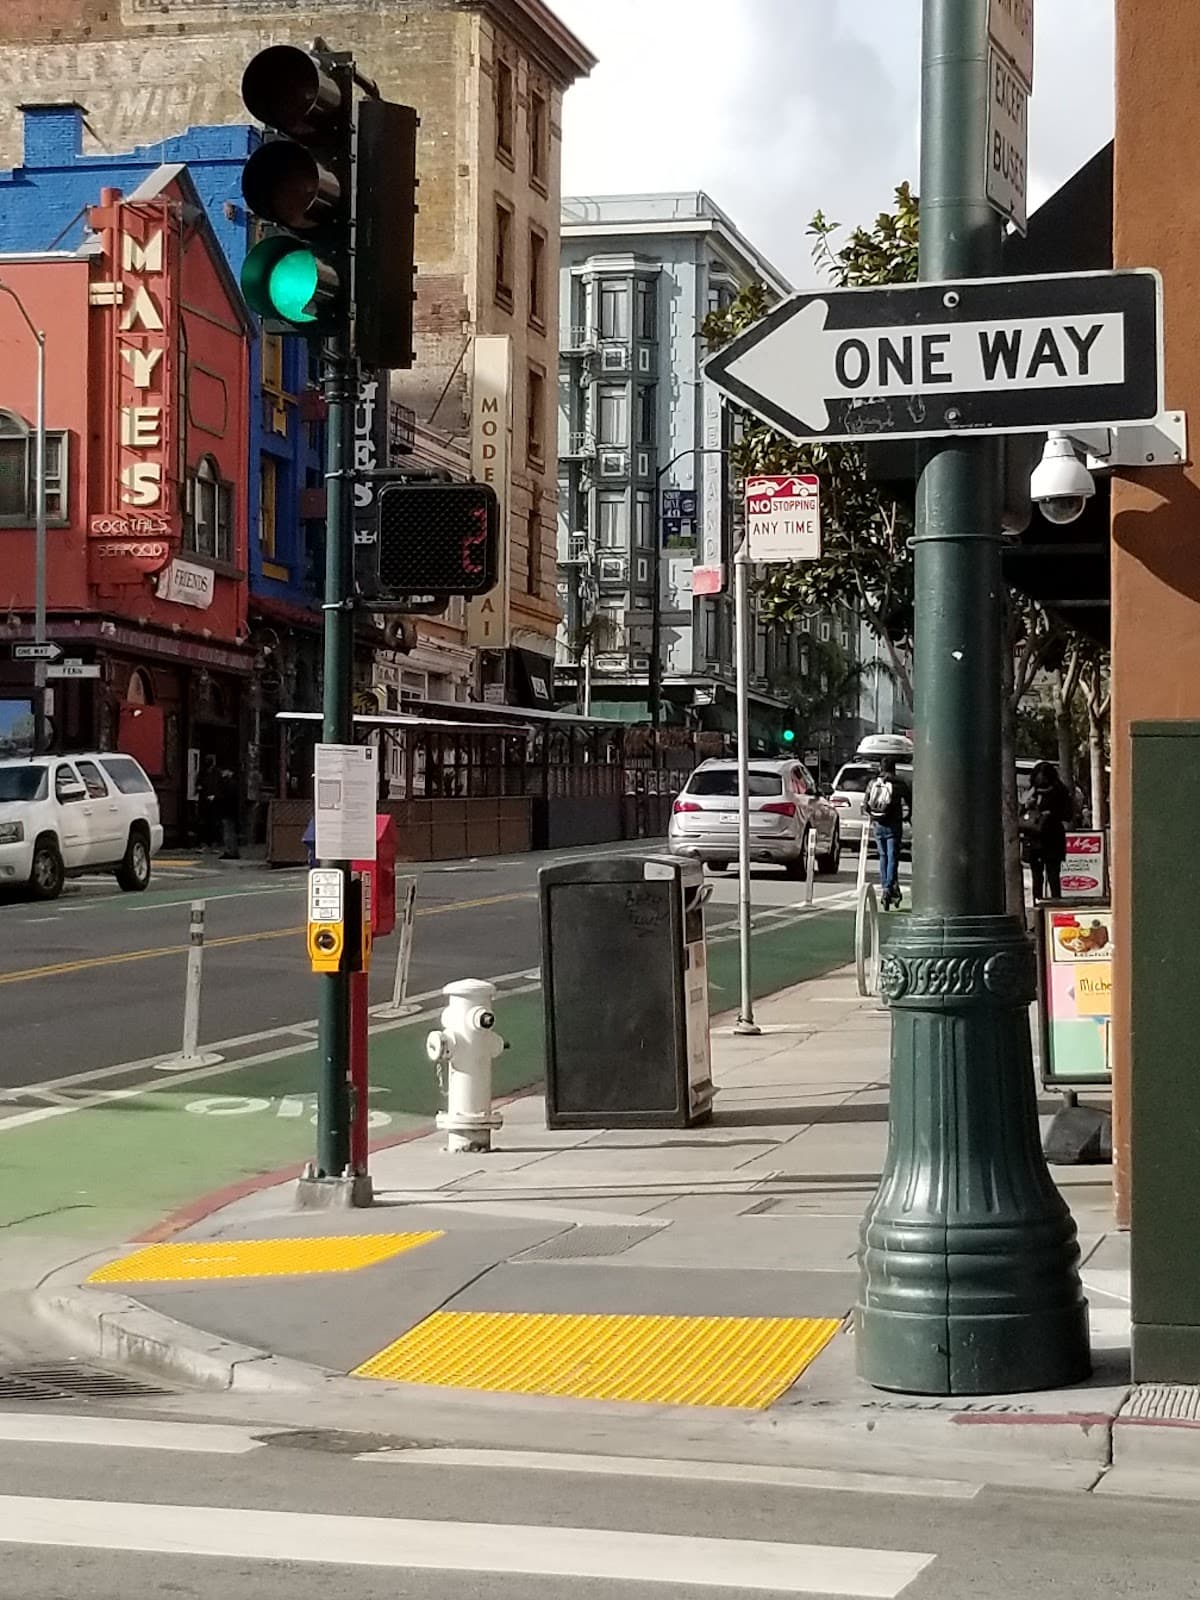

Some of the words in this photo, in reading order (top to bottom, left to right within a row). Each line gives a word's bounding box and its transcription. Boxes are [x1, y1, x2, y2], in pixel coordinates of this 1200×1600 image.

[995, 65, 1024, 130] EXCEPT
[993, 129, 1024, 198] BUSES
[119, 228, 164, 506] MAYES
[835, 333, 953, 389] ONE
[978, 324, 1105, 382] WAY
[750, 500, 771, 512] NO
[773, 500, 816, 512] STOPPING
[91, 518, 168, 534] COCKTAILS
[753, 522, 779, 535] ANY
[784, 521, 814, 534] TIME
[98, 543, 163, 557] SEAFOOD
[174, 568, 208, 592] FRIENDS
